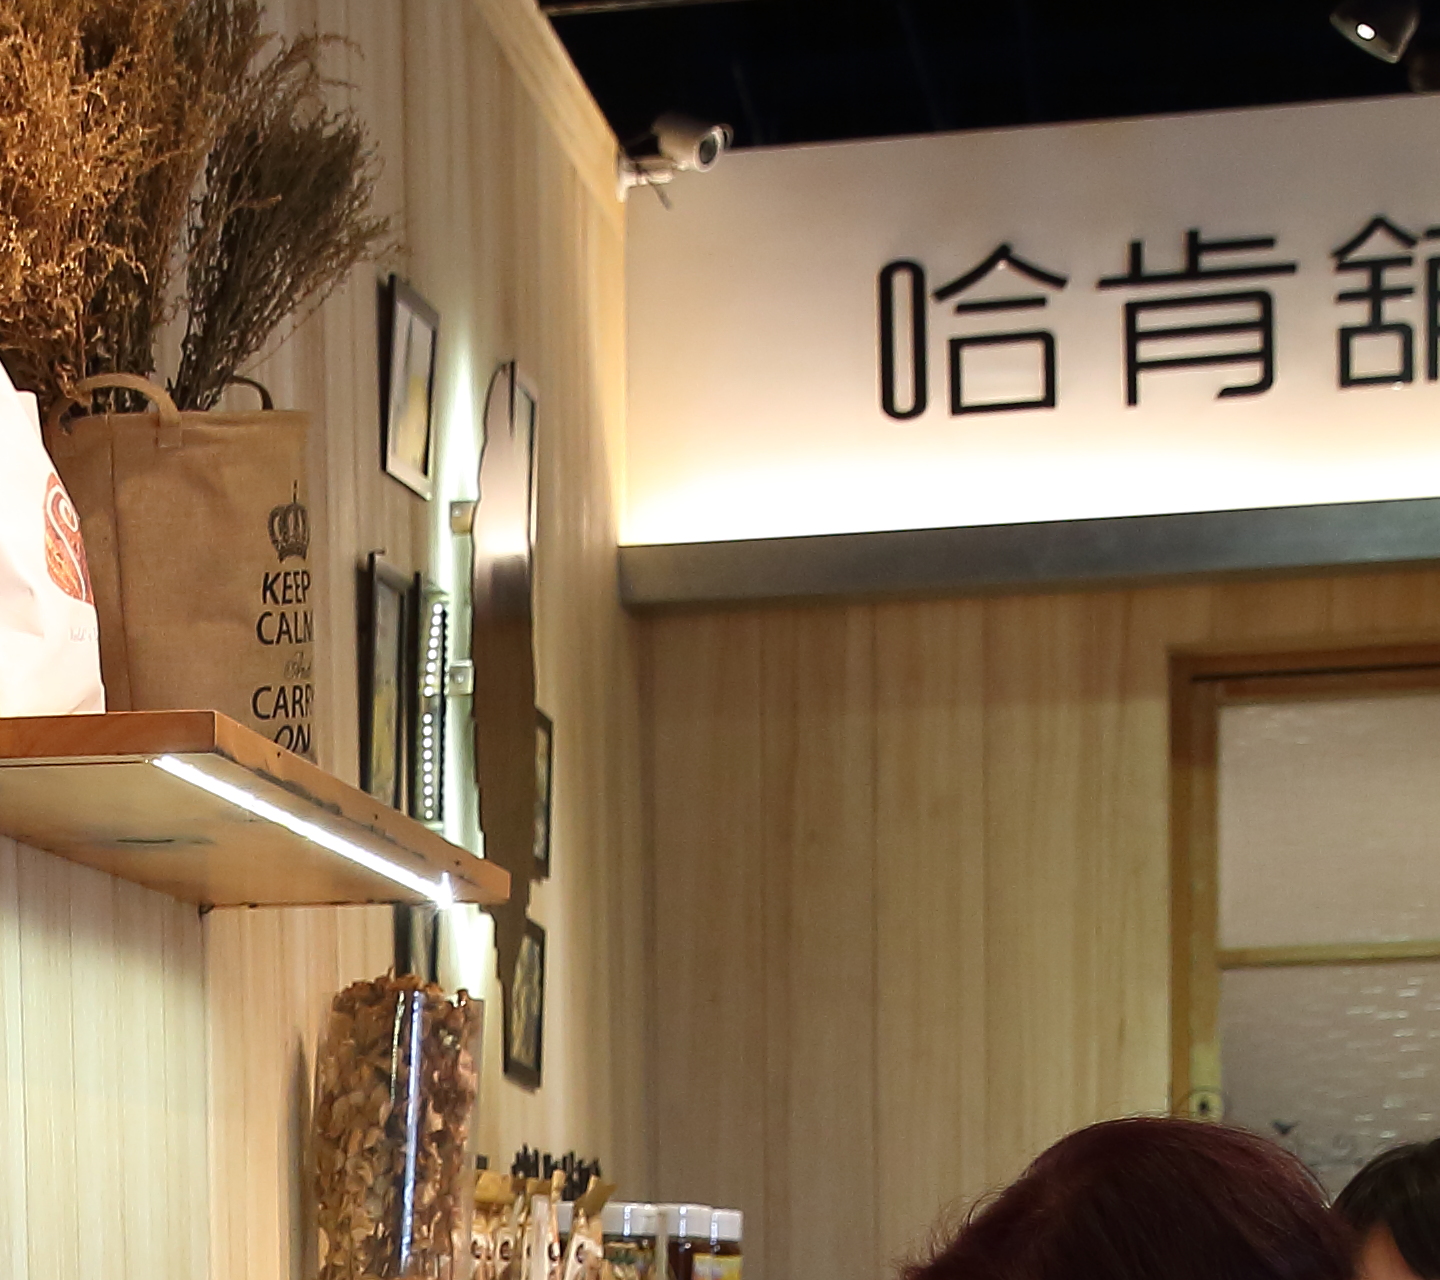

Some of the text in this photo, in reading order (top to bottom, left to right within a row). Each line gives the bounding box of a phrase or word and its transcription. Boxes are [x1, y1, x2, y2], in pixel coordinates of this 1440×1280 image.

[262, 570, 311, 605] KEEP
[256, 611, 314, 646] CALM
[251, 685, 315, 721] CARR
[274, 723, 311, 753] ON
